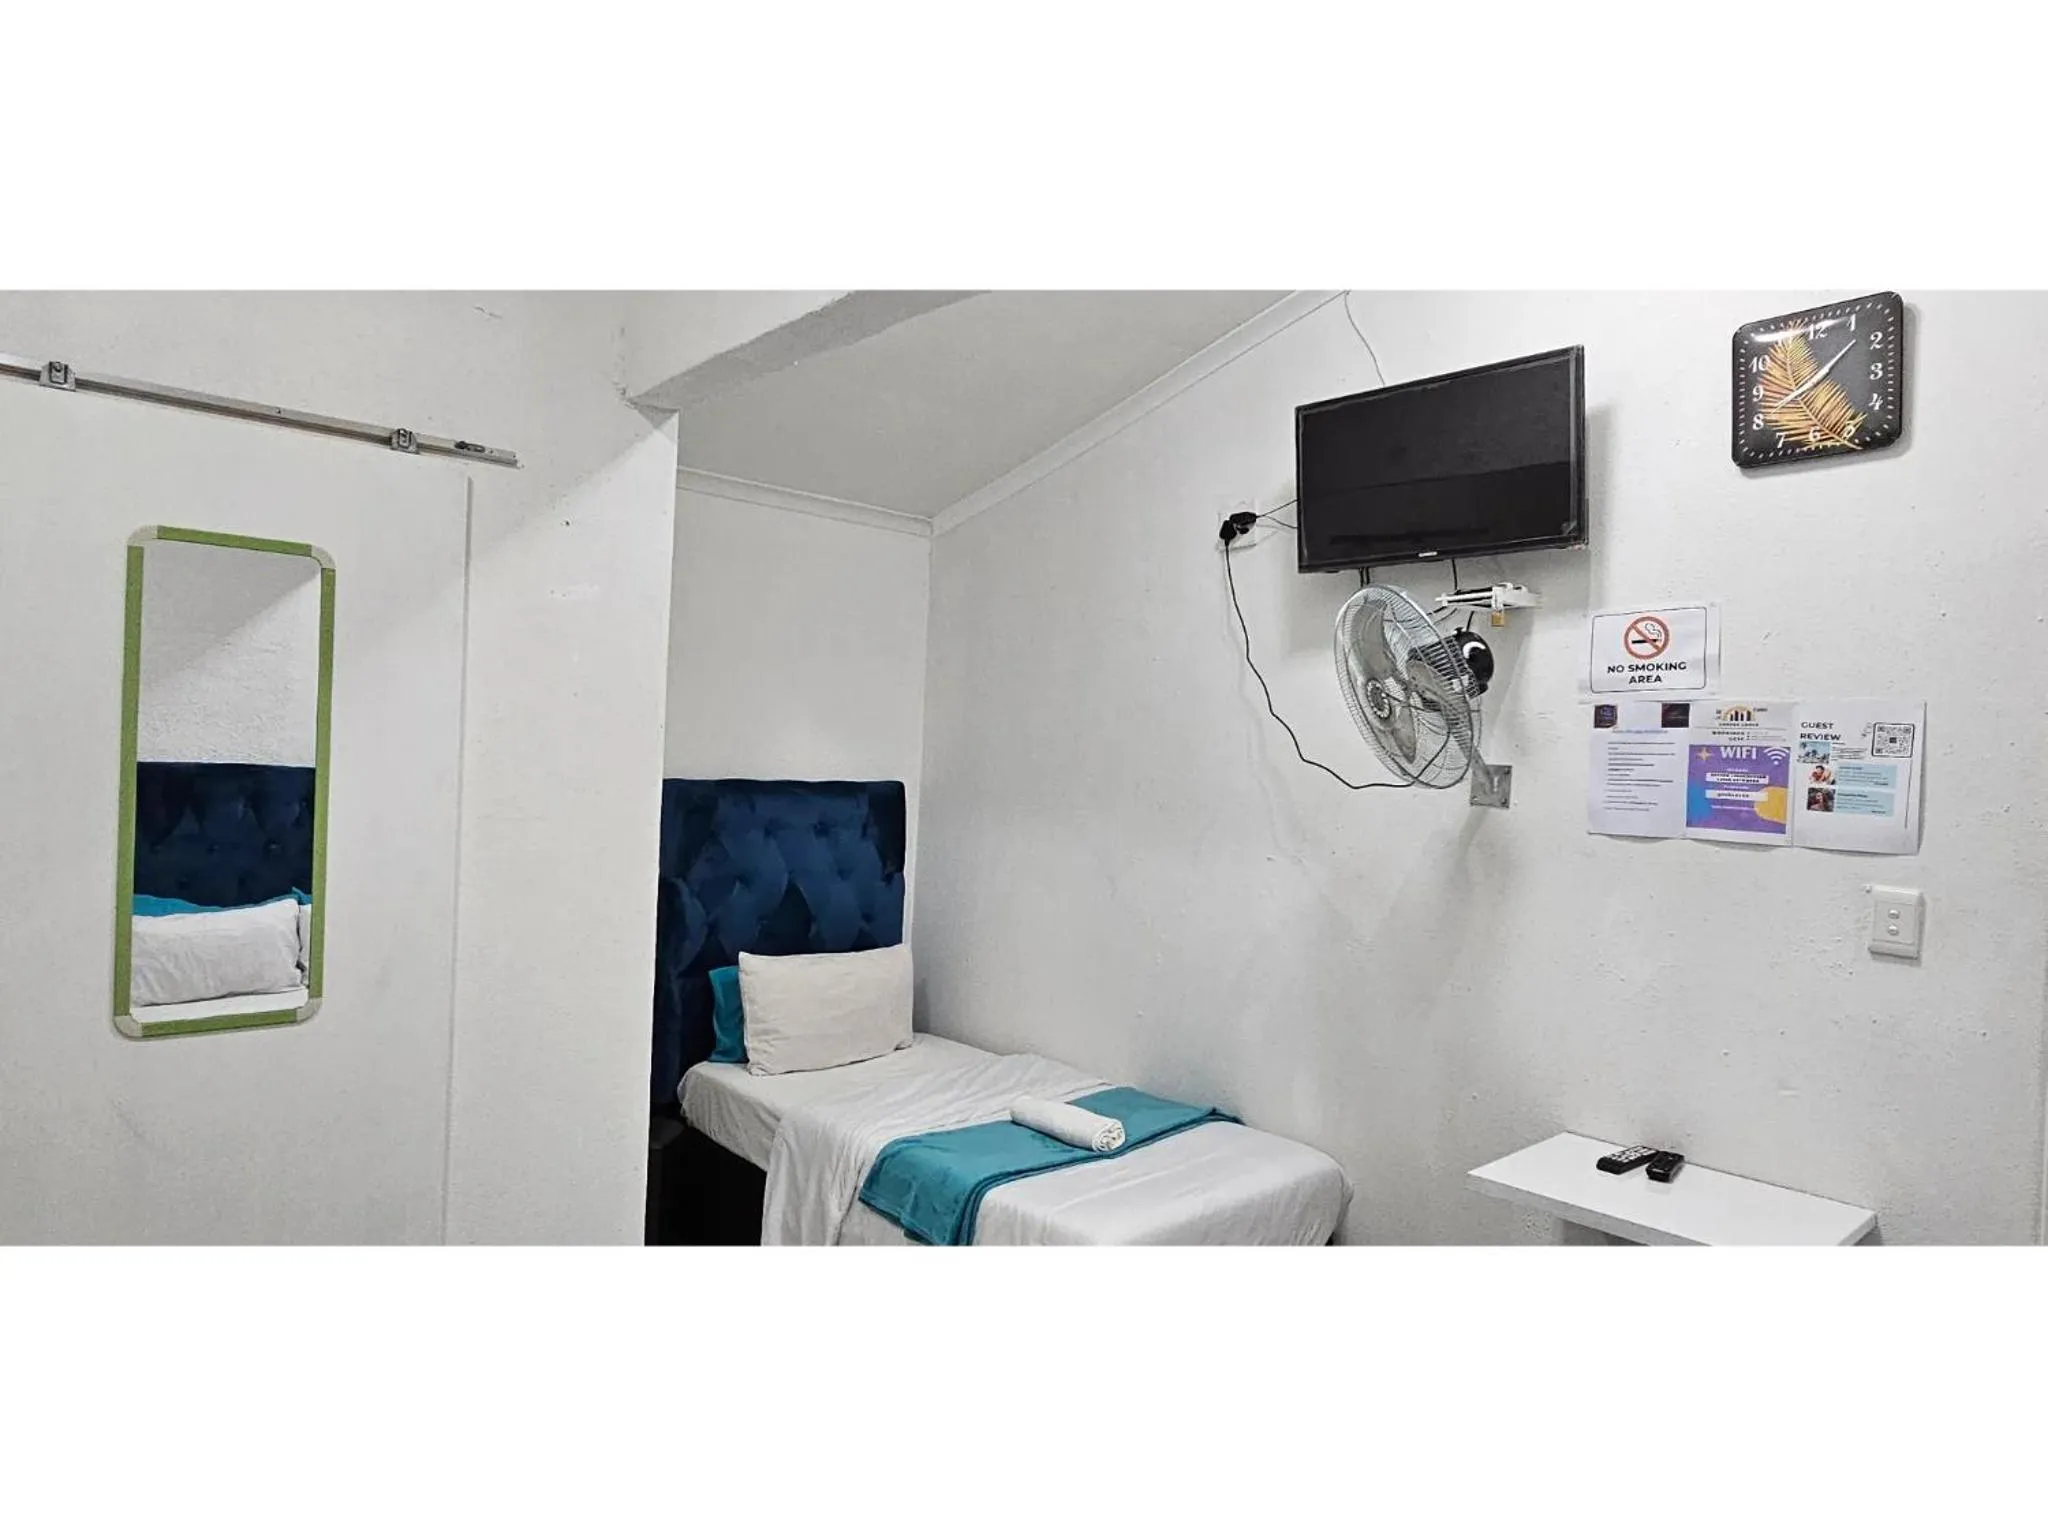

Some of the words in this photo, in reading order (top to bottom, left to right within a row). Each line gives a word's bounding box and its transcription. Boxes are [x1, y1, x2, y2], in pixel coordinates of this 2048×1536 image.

[1847, 313, 1857, 332] 1
[1807, 324, 1828, 340] 12
[1869, 331, 1884, 350] 2
[1749, 354, 1770, 373] 10
[1869, 362, 1884, 380] 3
[1752, 385, 1764, 402] 9
[1868, 392, 1884, 411] 4
[1752, 413, 1764, 430] 8
[1842, 420, 1856, 438] 5
[1775, 432, 1787, 449] 7
[1808, 425, 1821, 442] 6
[1607, 664, 1625, 674] NO
[1628, 661, 1688, 673] SMOKING
[1628, 674, 1663, 684] AREA
[1800, 721, 1835, 730] GUEST
[1799, 732, 1842, 741] REVIEW
[1720, 746, 1757, 760] WIFI
